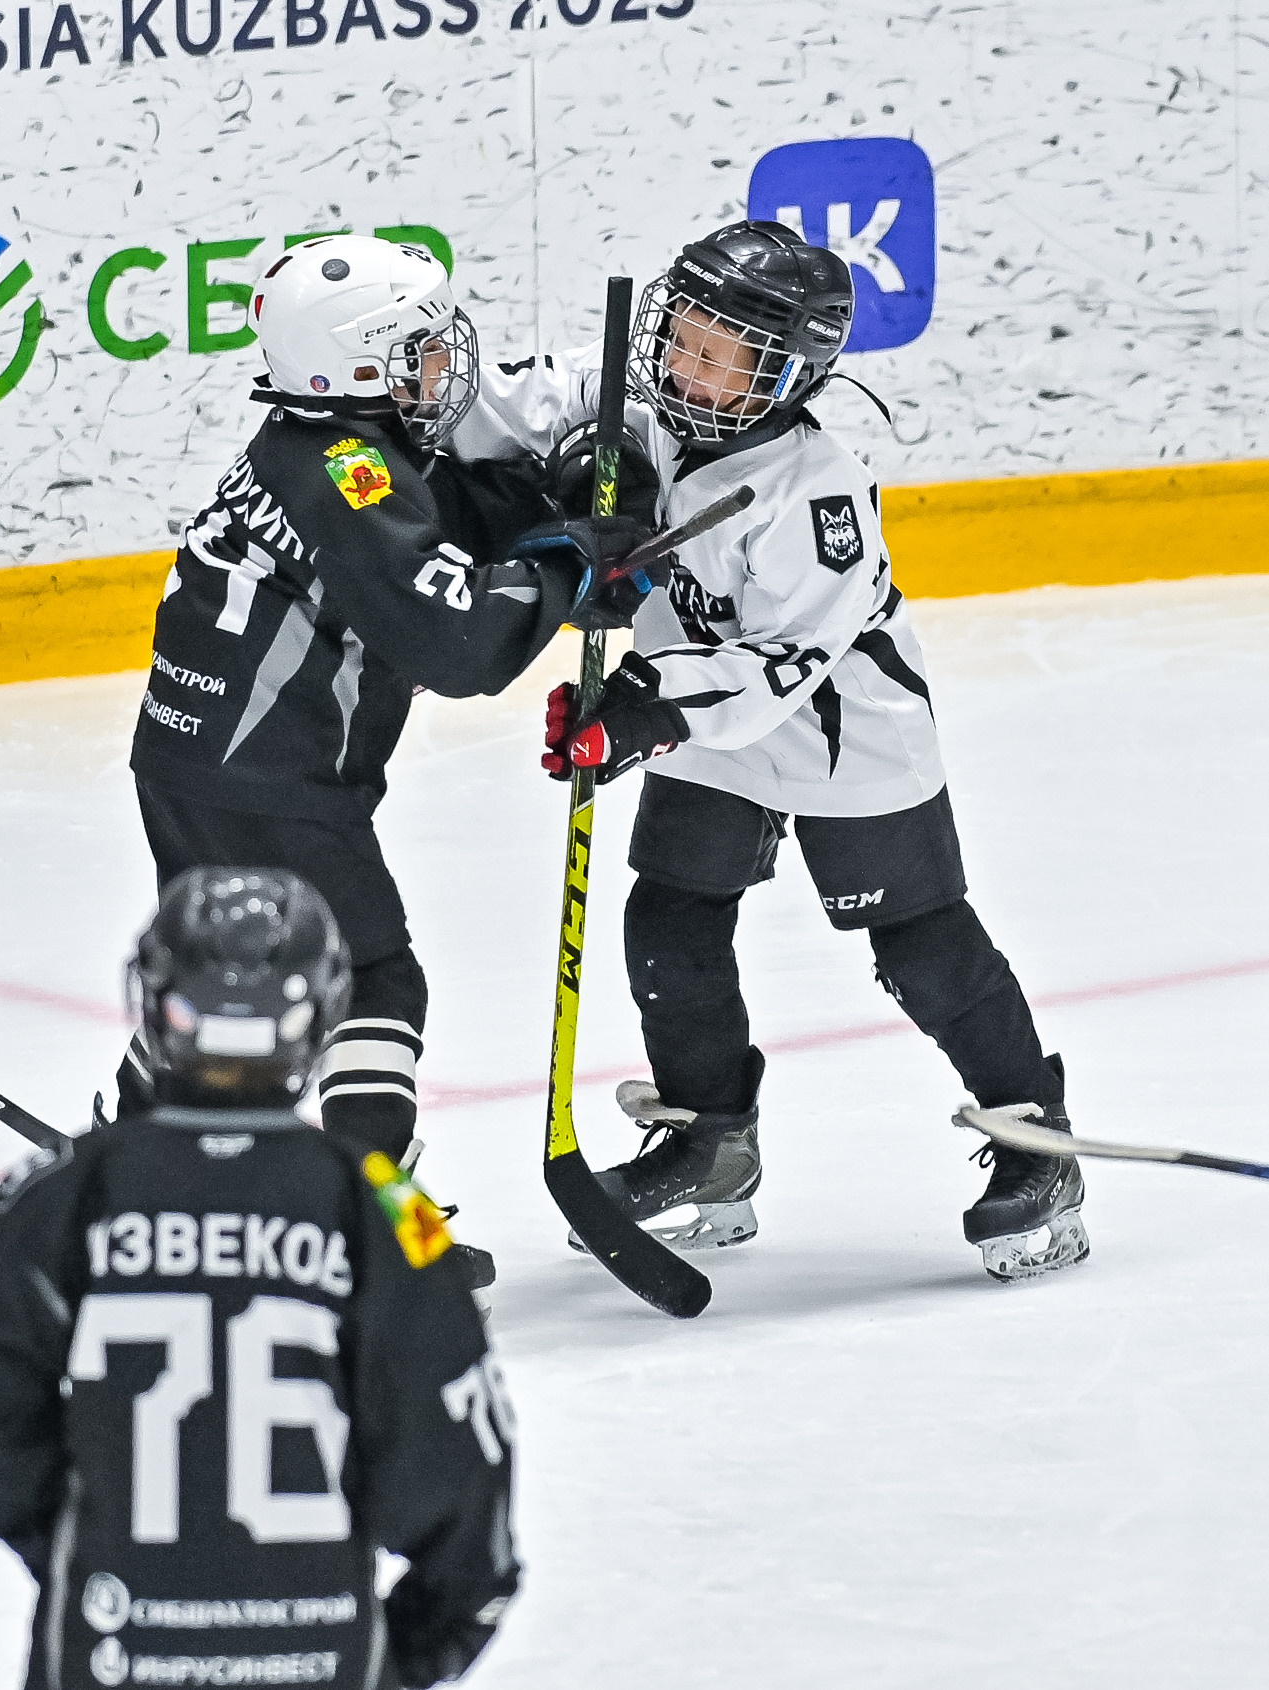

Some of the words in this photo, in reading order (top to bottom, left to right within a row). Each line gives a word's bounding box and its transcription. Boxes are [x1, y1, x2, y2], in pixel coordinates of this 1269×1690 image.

[121, 0, 481, 62] KUZBASS
[682, 259, 725, 287] BAUER
[364, 321, 398, 338] CCM
[822, 889, 884, 911] CCM
[68, 1292, 351, 1544] 76
